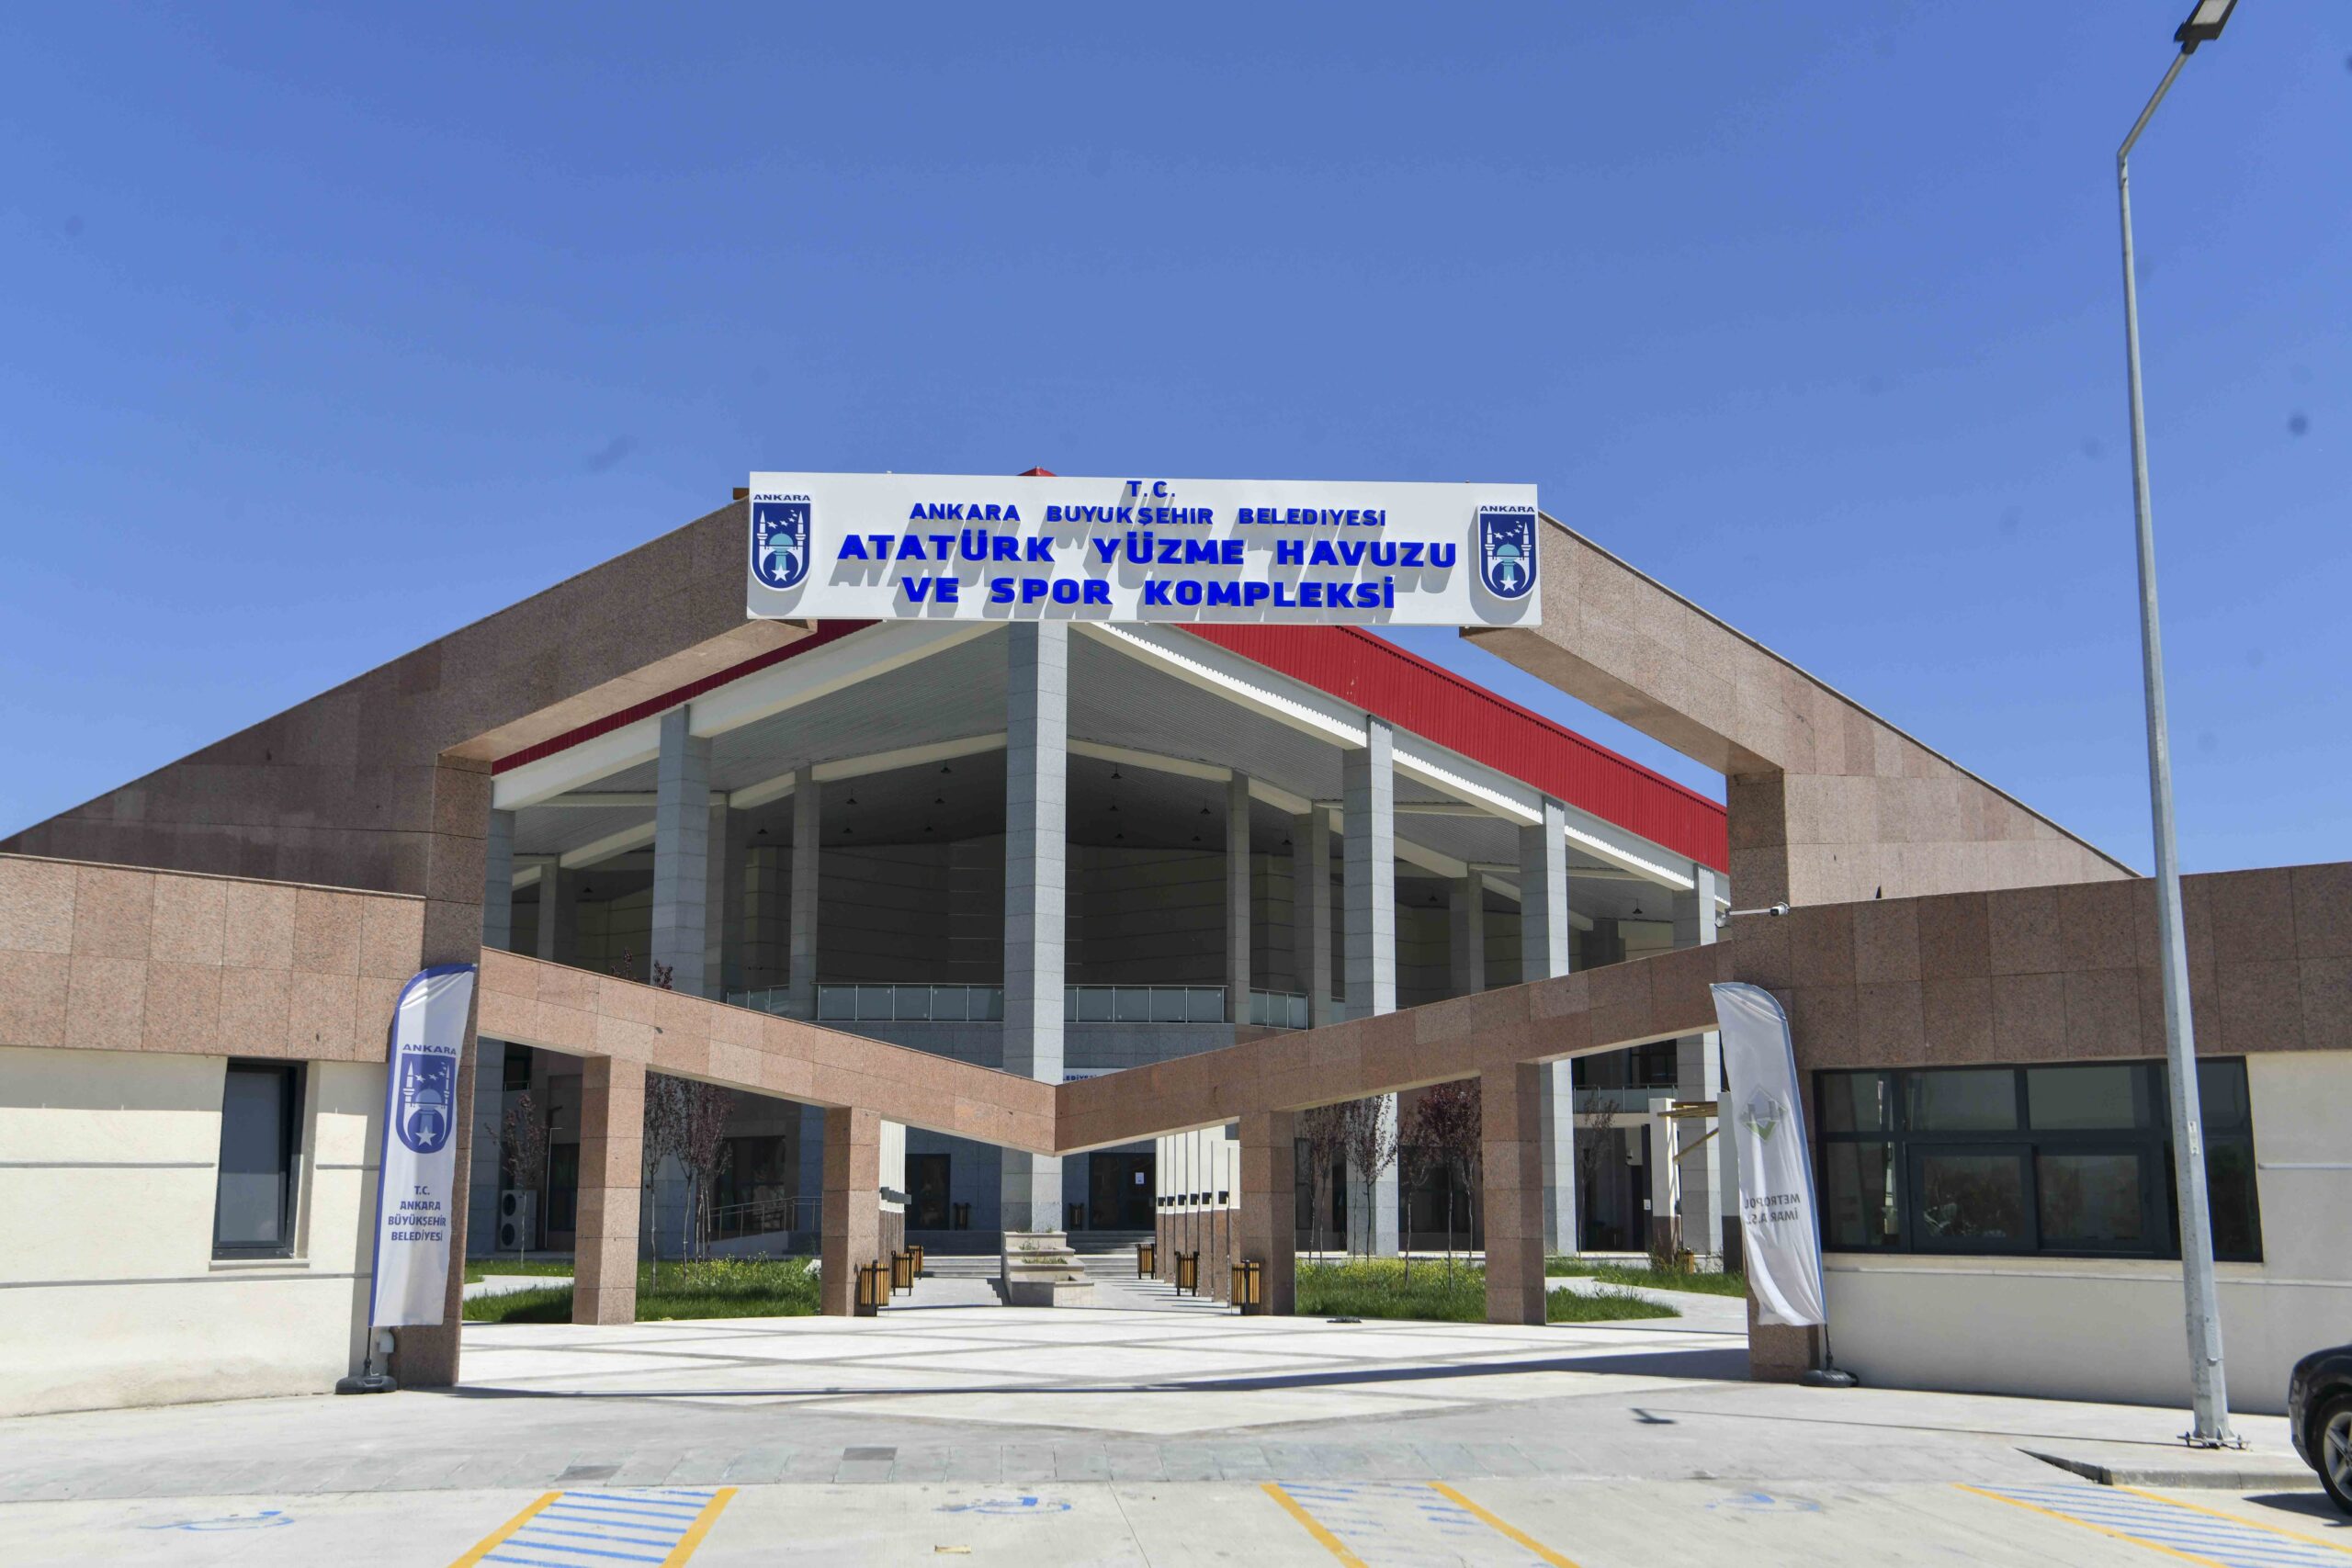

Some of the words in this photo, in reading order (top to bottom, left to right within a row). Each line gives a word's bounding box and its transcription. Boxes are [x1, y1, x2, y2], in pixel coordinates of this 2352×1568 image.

[1125, 479, 1176, 499] T.C.
[753, 493, 810, 502] ANKARA
[910, 502, 1022, 523] ANKARA
[836, 528, 1056, 563] ATATÜRK
[1091, 530, 1246, 566] YÜZME
[1276, 539, 1457, 570] HAVUZU
[900, 576, 960, 604] VE
[990, 577, 1114, 606] SPOR
[1144, 575, 1396, 610] KOMPLEKSİ
[402, 1043, 457, 1055] ANKARA
[414, 1185, 430, 1196] T.C.
[400, 1201, 442, 1211] ANKARA
[388, 1213, 447, 1227] BÜYÜKŞEHİR
[391, 1229, 443, 1242] BELEDİYESİ
